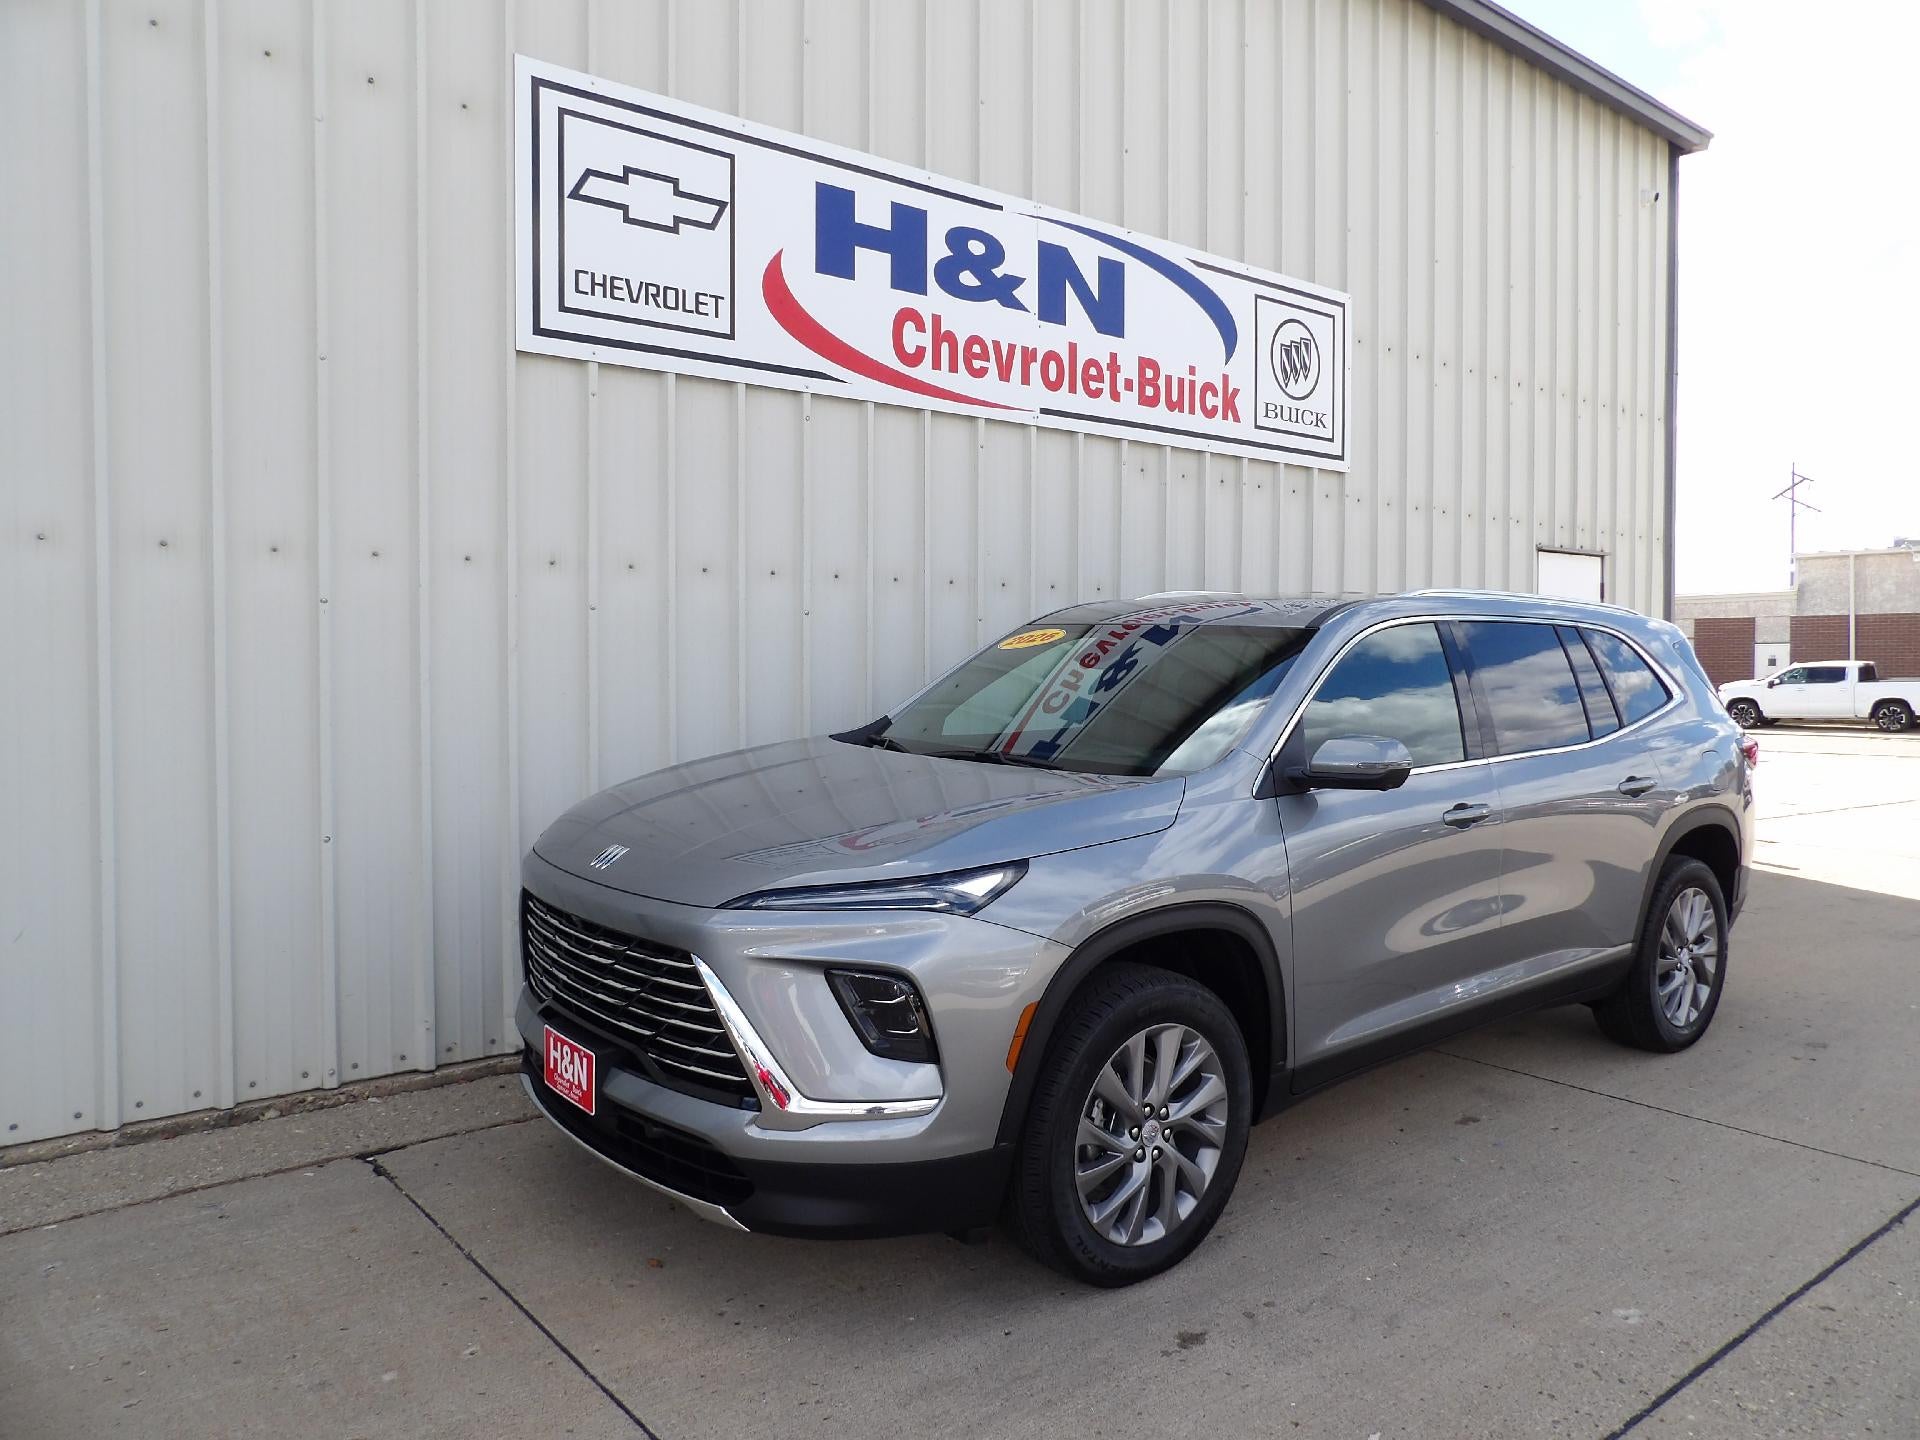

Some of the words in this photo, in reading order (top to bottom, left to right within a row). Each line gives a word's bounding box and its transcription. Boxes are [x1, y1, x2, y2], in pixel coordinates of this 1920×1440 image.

[815, 181, 1125, 339] H&N
[574, 269, 725, 319] CHEVROLET
[1263, 401, 1327, 429] BUICK
[550, 1037, 588, 1091] H&N
